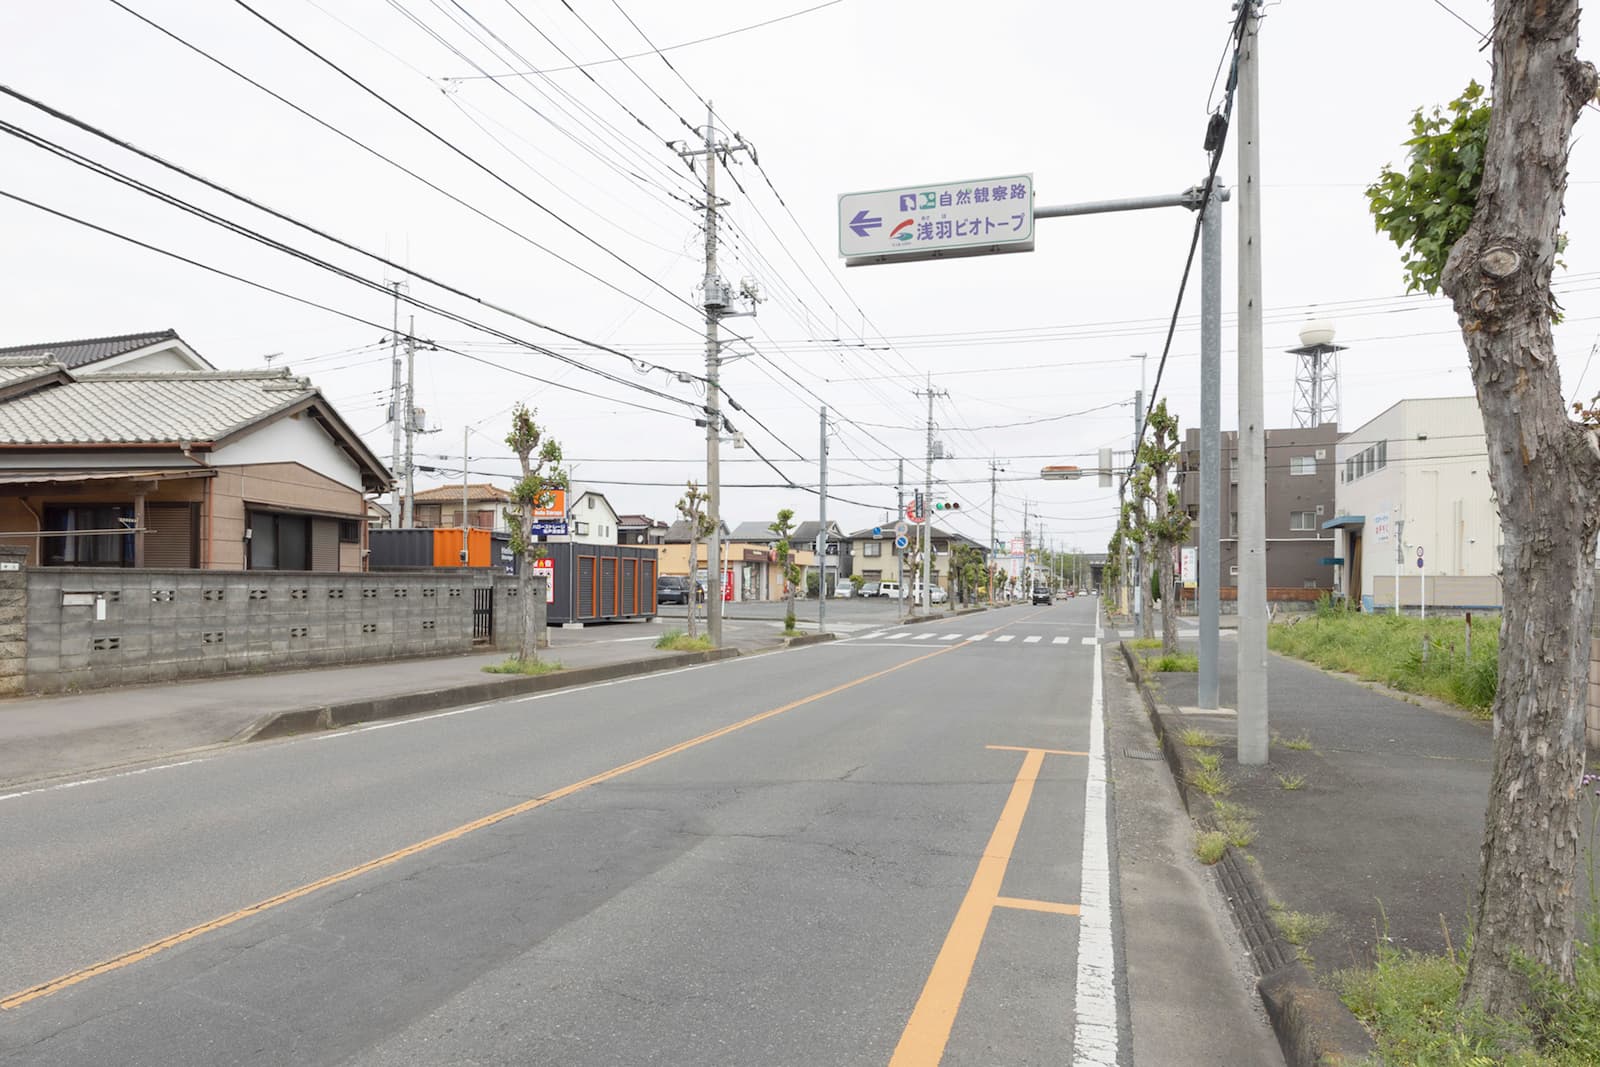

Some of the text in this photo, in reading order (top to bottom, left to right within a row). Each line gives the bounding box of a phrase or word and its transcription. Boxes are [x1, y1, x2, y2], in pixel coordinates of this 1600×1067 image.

[939, 183, 1027, 207] 自然観察路
[916, 212, 1026, 241] 浅羽ビオトープ
